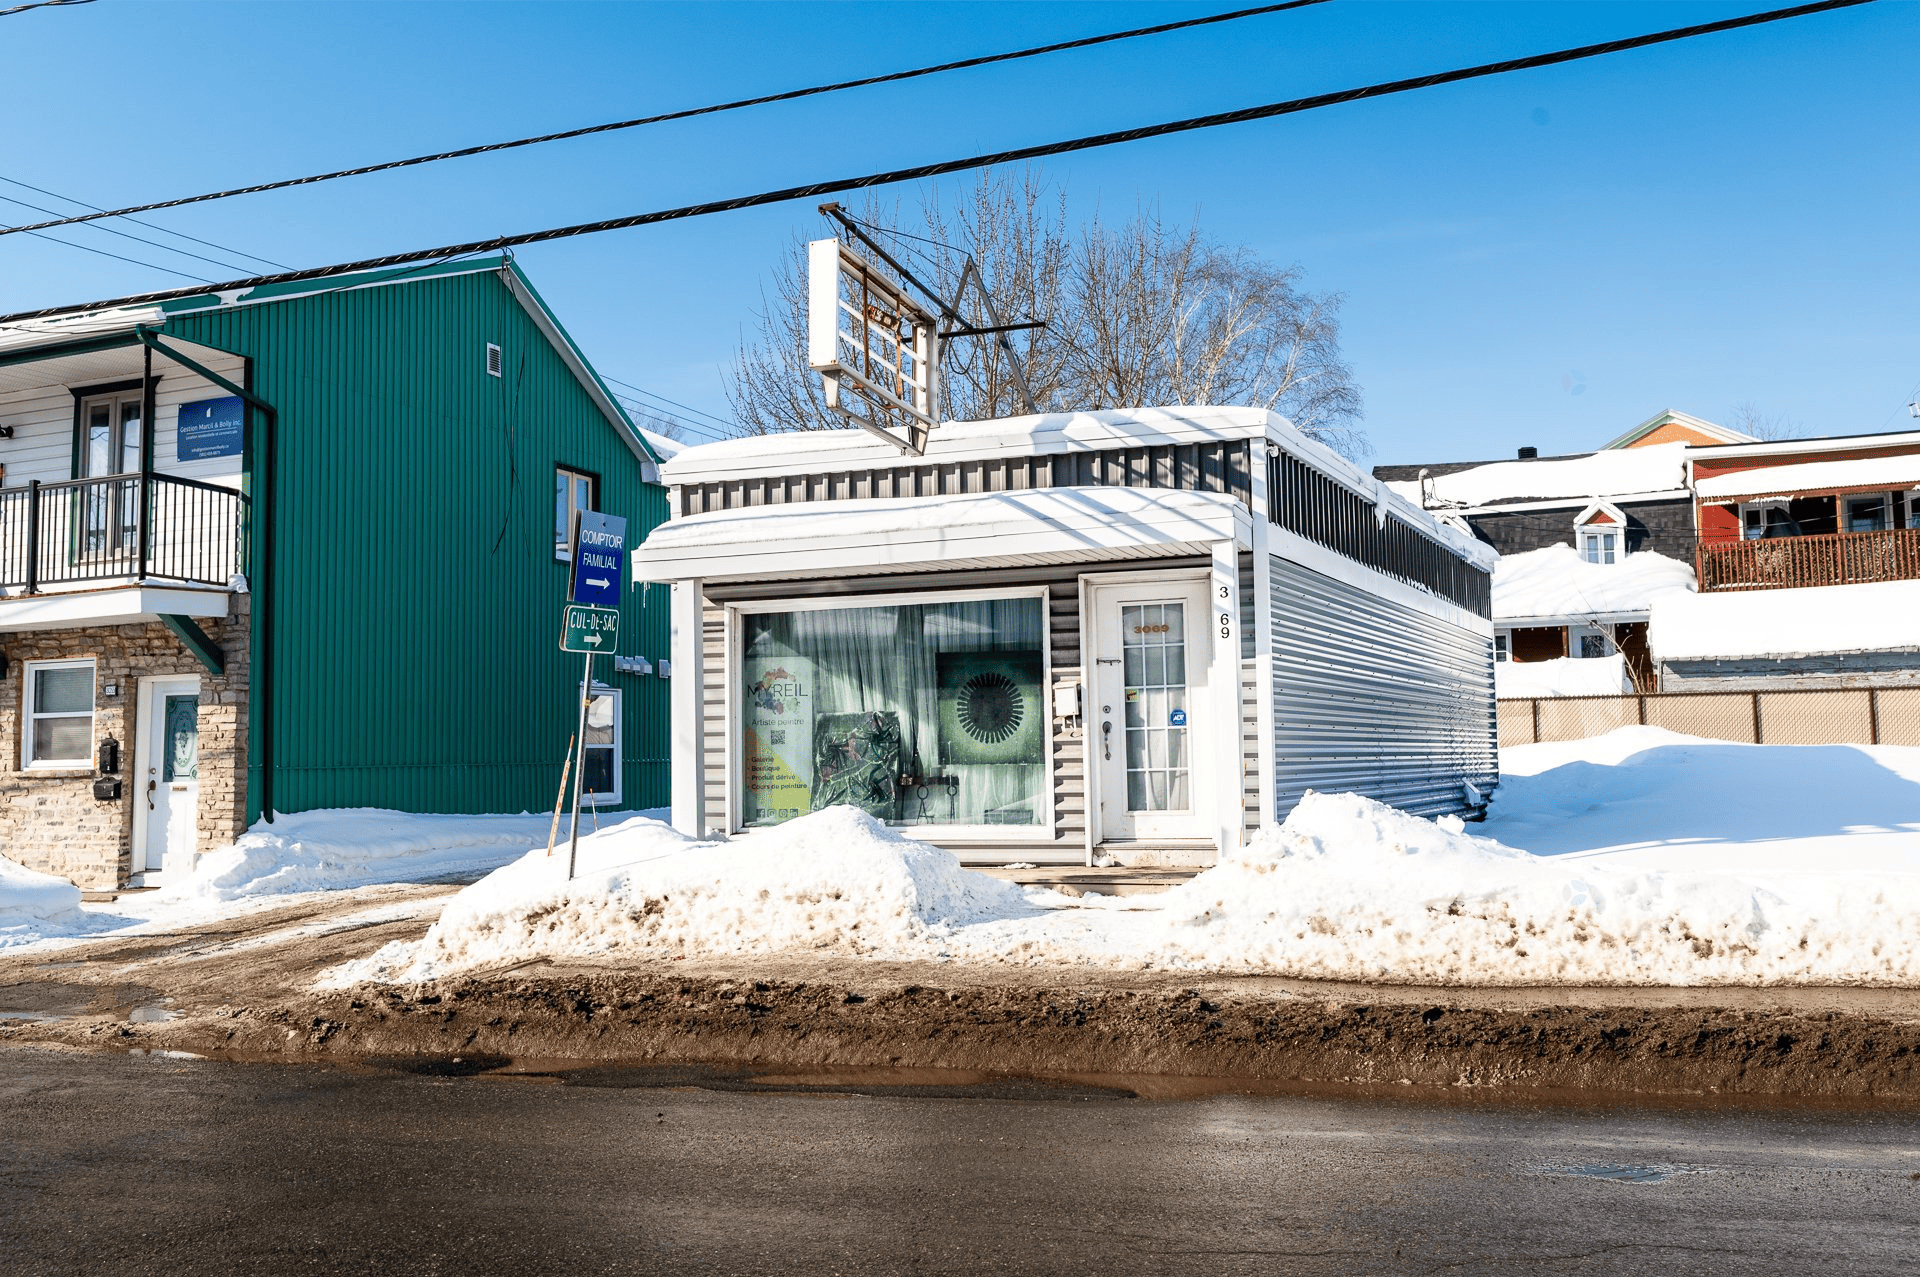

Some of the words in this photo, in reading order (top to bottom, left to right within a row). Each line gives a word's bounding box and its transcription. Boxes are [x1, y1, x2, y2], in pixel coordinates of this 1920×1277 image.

[581, 529, 623, 549] COMPTOIR
[583, 552, 617, 570] FAMILIAL
[570, 611, 617, 632] CUL-DE-SAC
[1134, 624, 1170, 634] 3069
[747, 683, 809, 698] MYREIL
[777, 719, 805, 727] peintre
[780, 783, 808, 791] peinture
